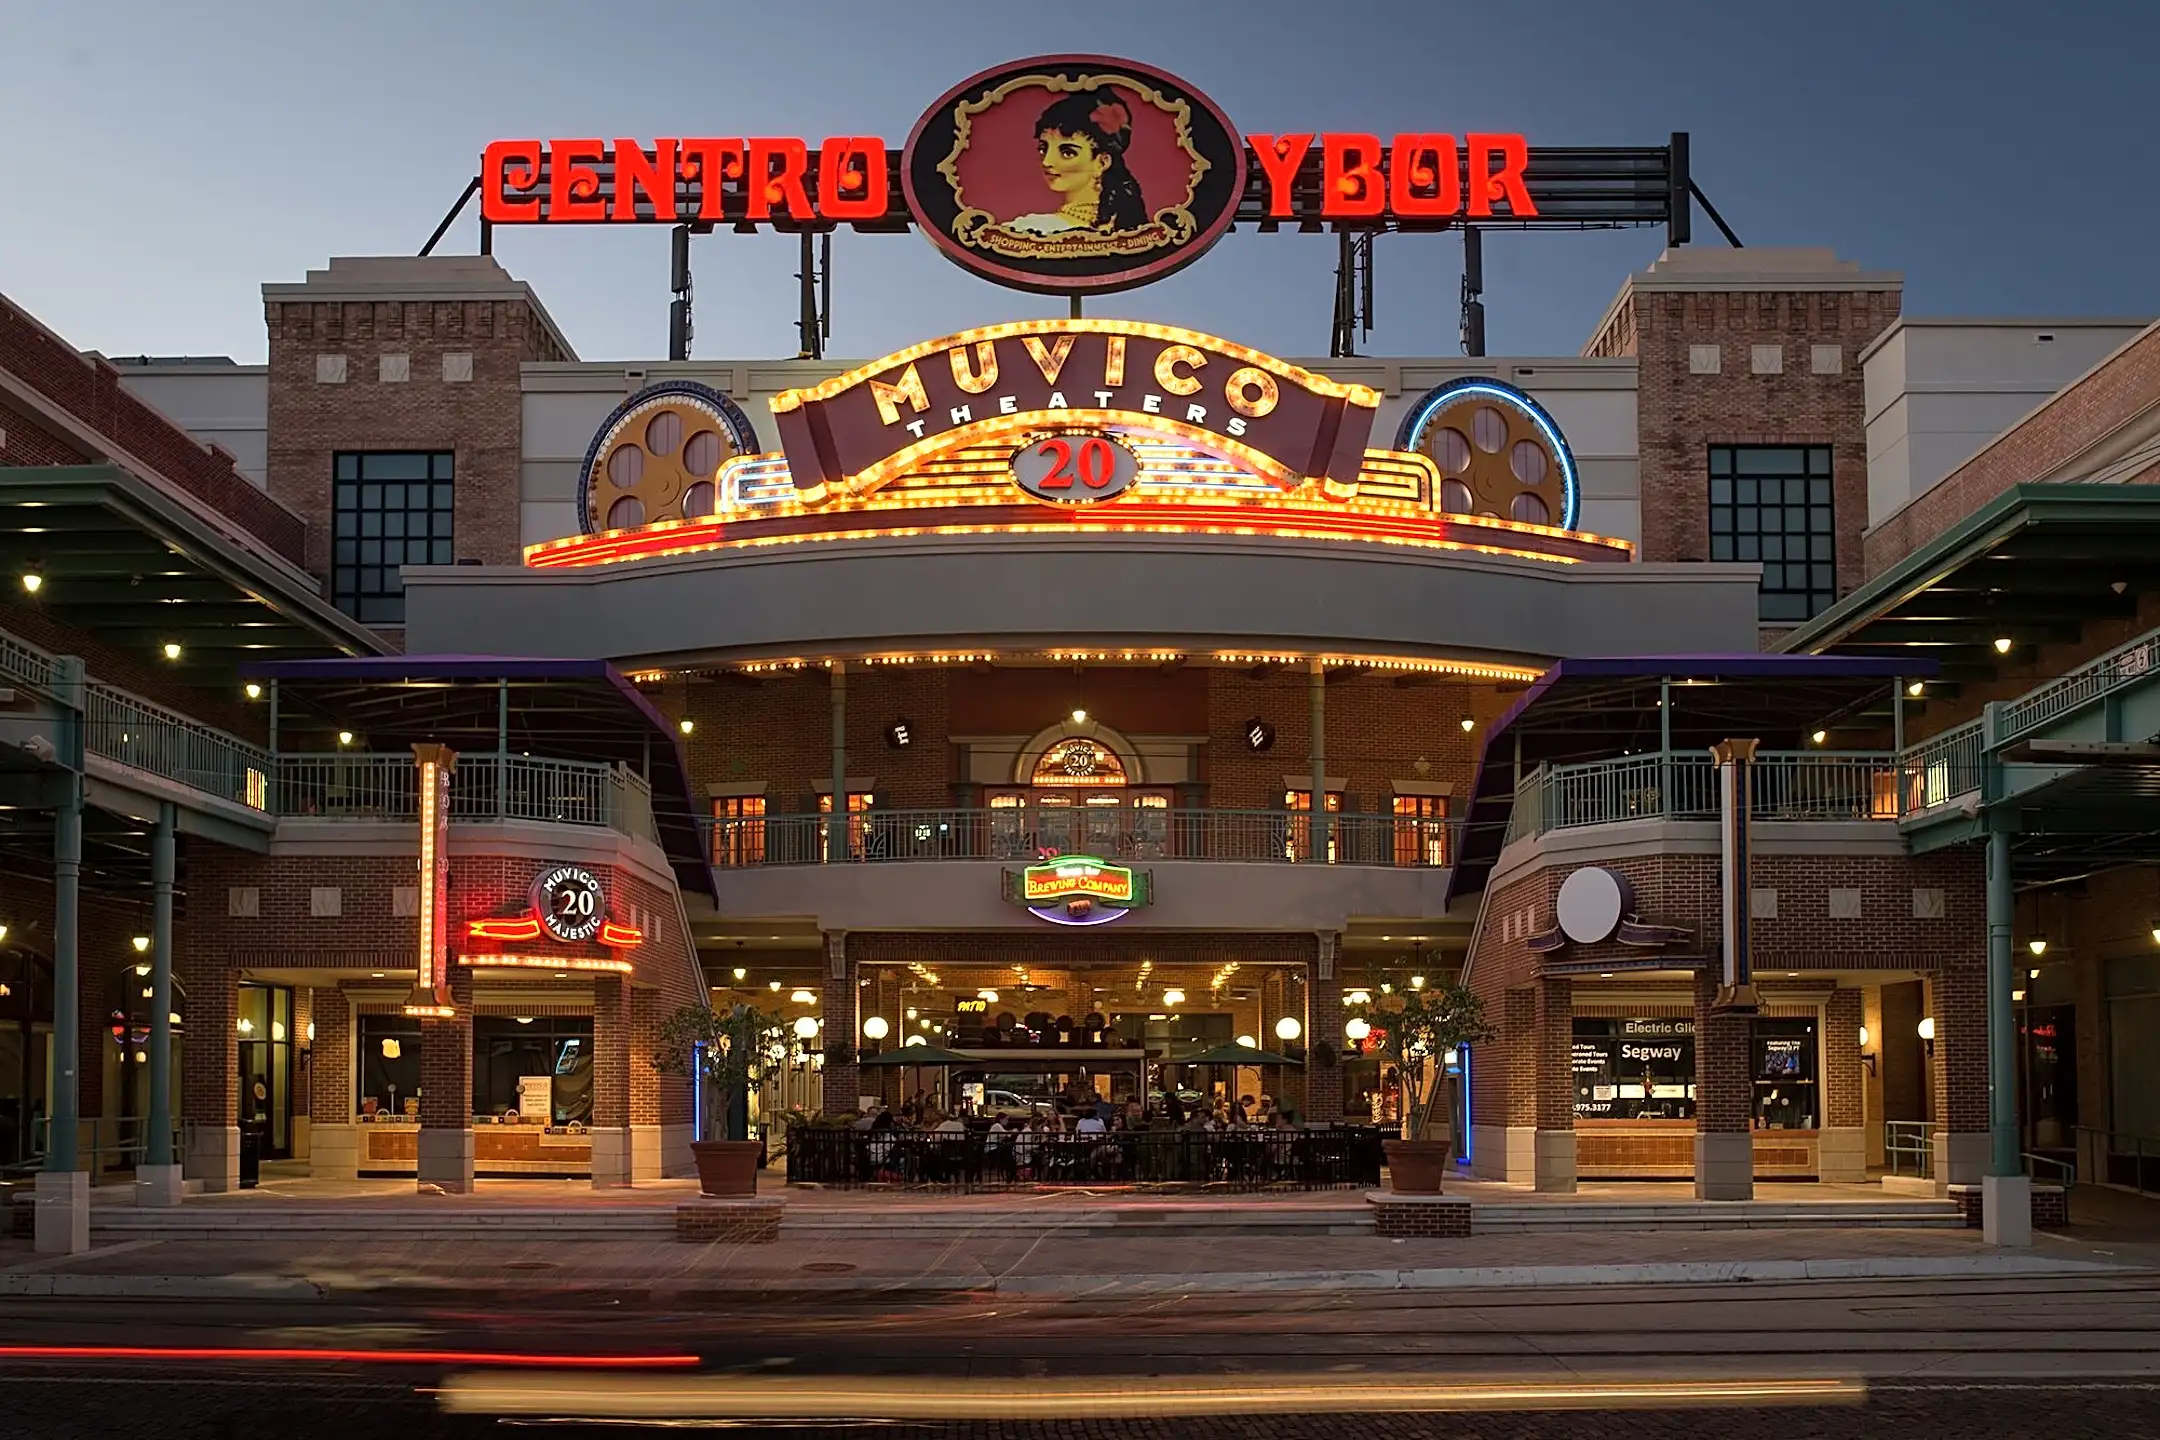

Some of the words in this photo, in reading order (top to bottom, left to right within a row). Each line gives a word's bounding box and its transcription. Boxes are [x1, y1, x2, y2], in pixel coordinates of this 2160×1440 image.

[483, 136, 889, 222] CENTRO
[1245, 132, 1540, 217] YBOR
[989, 233, 1038, 251] SHOPPING
[1043, 239, 1119, 253] ENTERTAINMENT
[1127, 232, 1161, 249] DINING
[868, 335, 1280, 427] MUVICO
[906, 391, 1248, 439] THEATERS
[1037, 438, 1116, 490] 20
[1071, 755, 1088, 767] 20
[543, 867, 599, 893] MUVICO
[1028, 878, 1077, 894] BREWING
[1078, 876, 1128, 894] COMPANY
[556, 889, 595, 916] 20
[545, 914, 601, 940] MAJESTIC
[957, 1000, 987, 1012] PATIO
[1625, 1022, 1672, 1034] Electric
[1621, 1044, 1682, 1062] Segway
